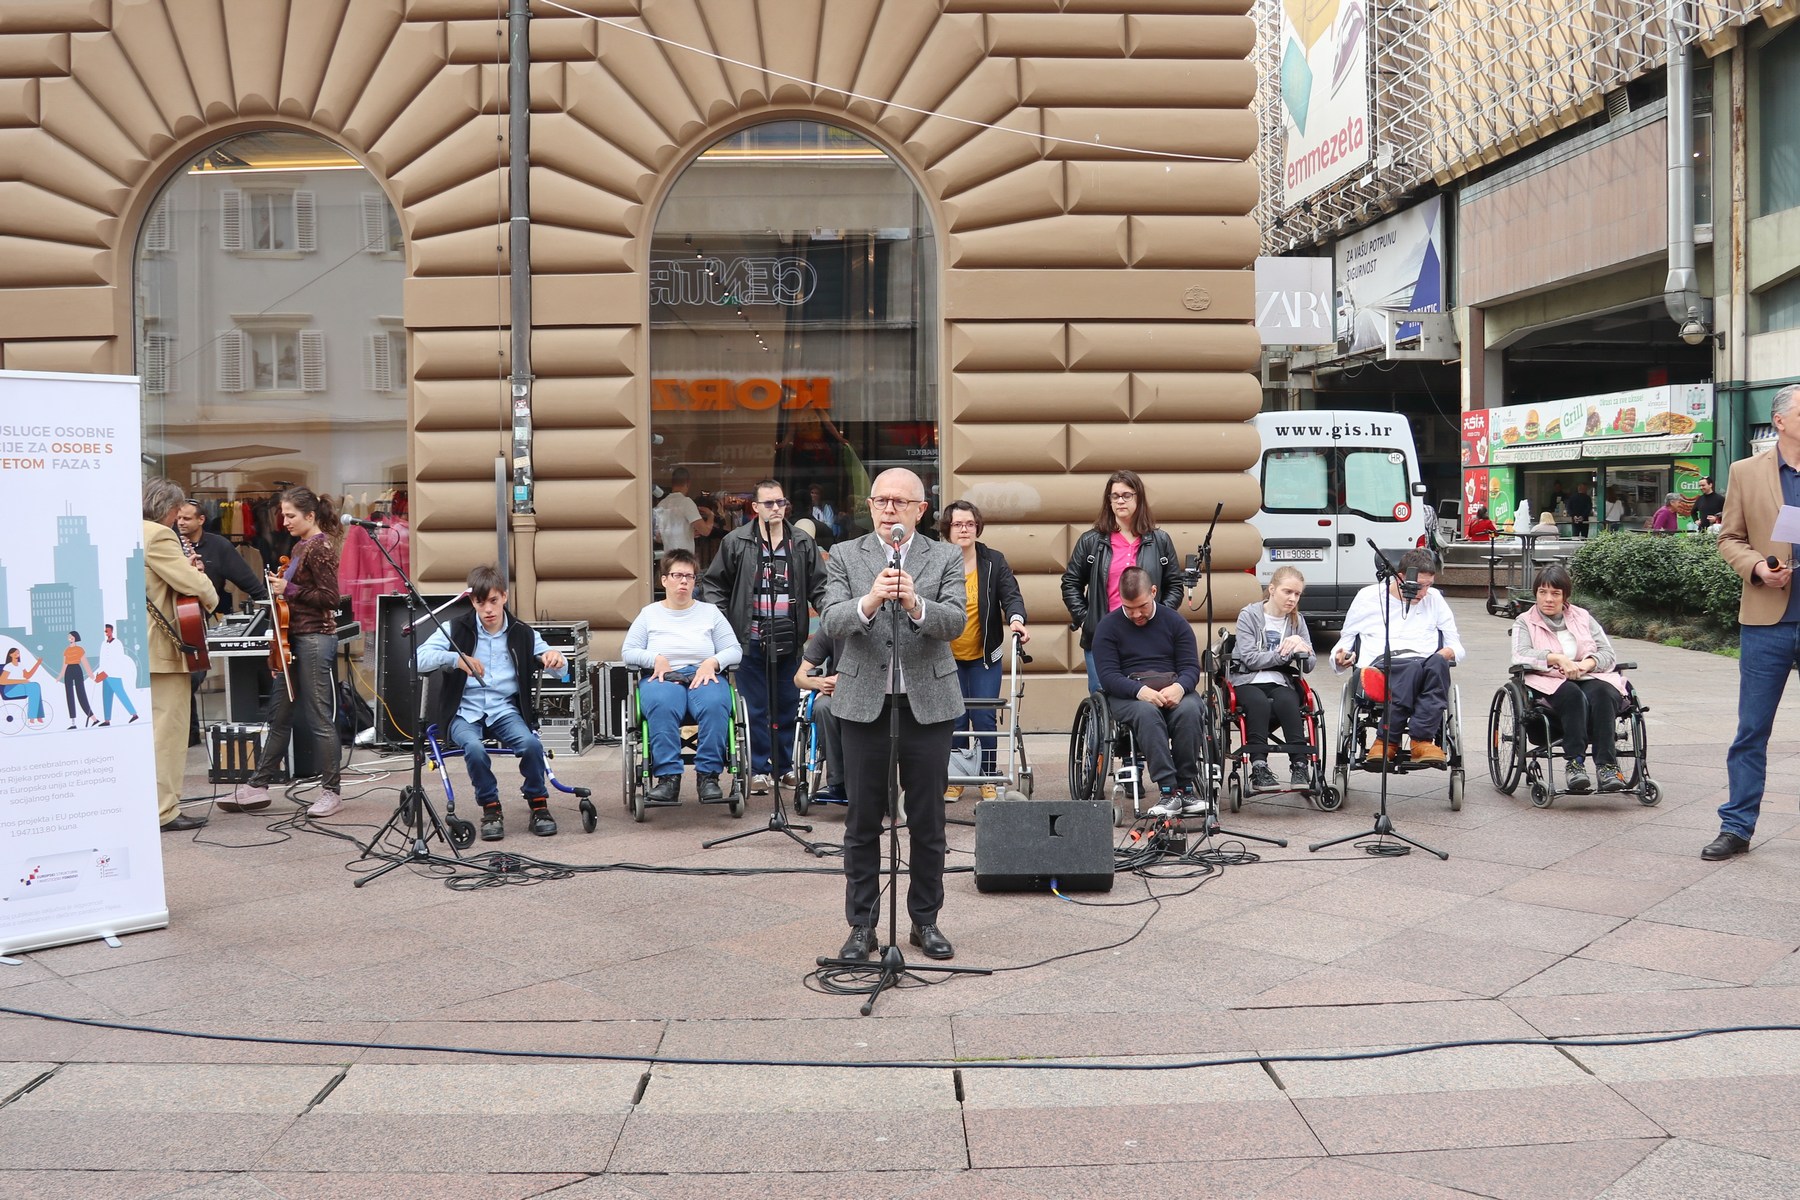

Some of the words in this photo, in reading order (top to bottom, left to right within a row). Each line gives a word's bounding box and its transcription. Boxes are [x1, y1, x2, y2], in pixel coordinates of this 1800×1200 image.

[1287, 116, 1363, 189] emmezeta
[1346, 249, 1353, 263] ZA
[1369, 230, 1397, 252] POTPUNU
[1346, 258, 1377, 282] SIGURNOST
[1255, 291, 1332, 328] ZARA
[1563, 402, 1583, 427] Grill
[54, 426, 115, 438] OSOBNE
[1275, 422, 1392, 440] www.gis.hr
[27, 442, 48, 453] ZA
[51, 442, 101, 453] OSOBE
[104, 443, 113, 454] S
[52, 459, 90, 469] FAZA
[93, 459, 101, 469] 3
[1397, 507, 1407, 516] 80
[29, 759, 79, 771] cerebralnom
[8, 774, 32, 785] Rijeka
[65, 767, 91, 778] projekt
[92, 765, 114, 774] kojeg
[10, 783, 47, 795] Europska
[48, 781, 67, 790] unija
[76, 775, 117, 786] Europskog
[10, 793, 50, 805] socijalnog
[17, 815, 50, 826] projekta
[55, 812, 67, 820] EU
